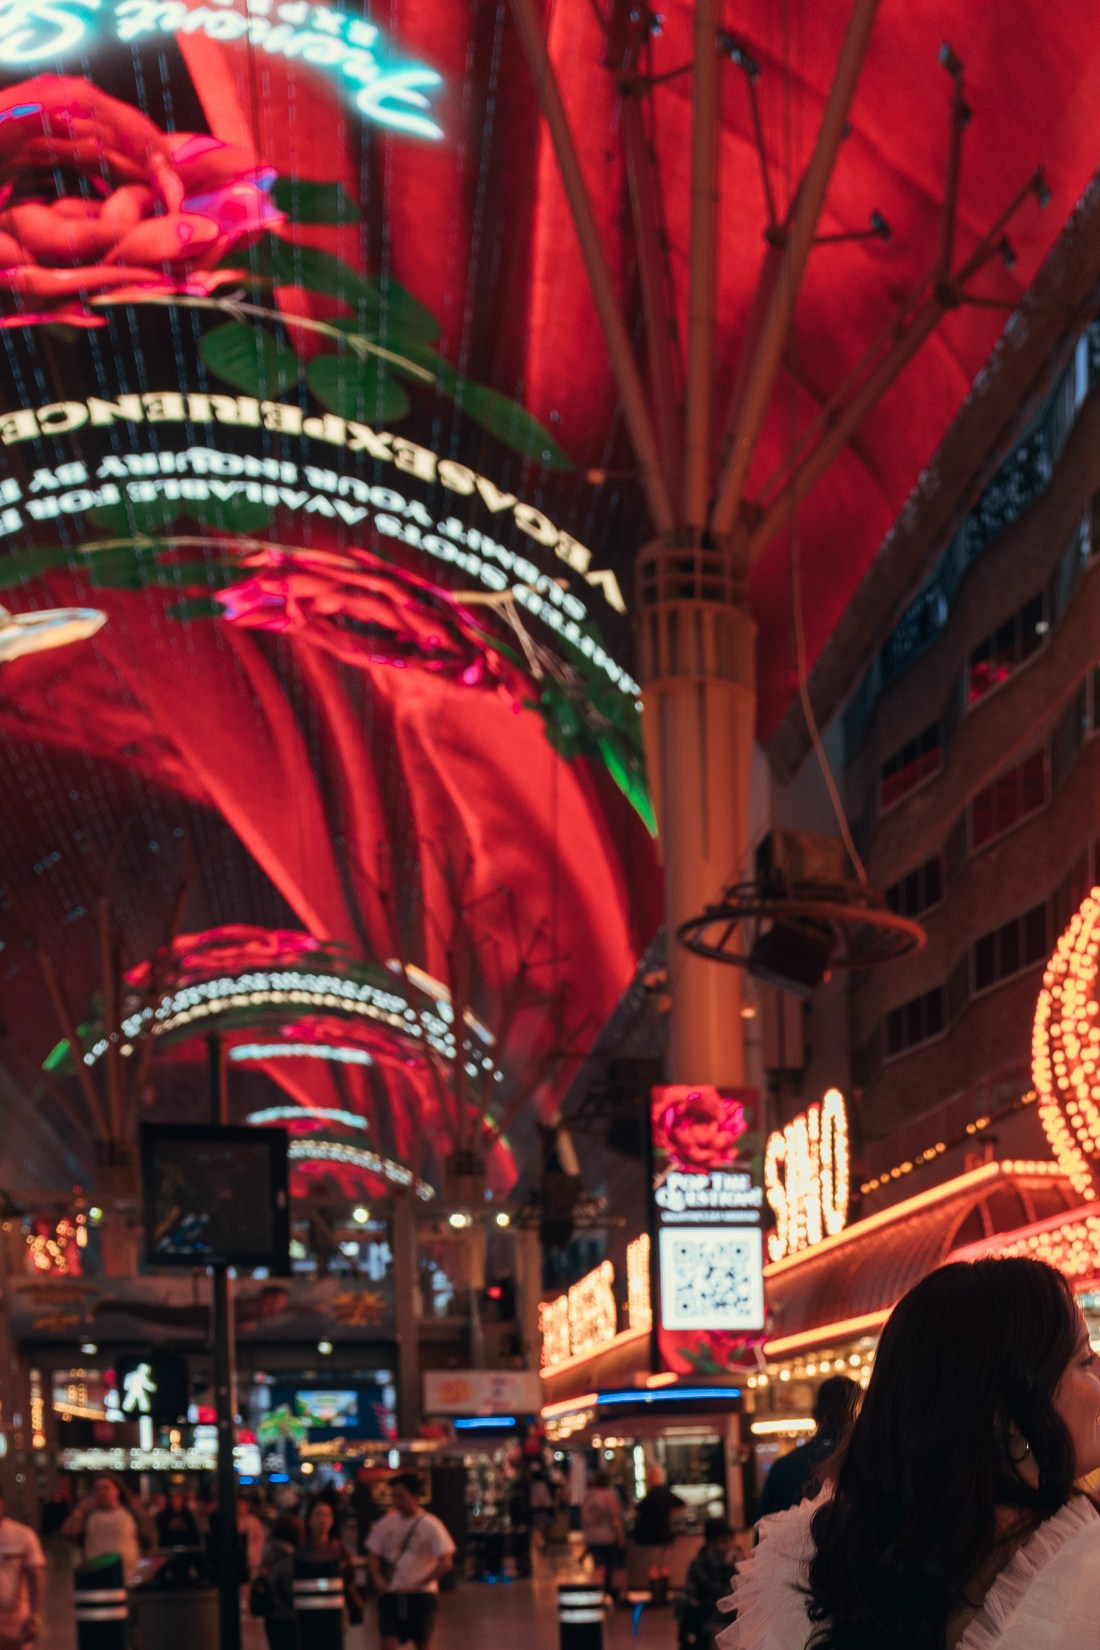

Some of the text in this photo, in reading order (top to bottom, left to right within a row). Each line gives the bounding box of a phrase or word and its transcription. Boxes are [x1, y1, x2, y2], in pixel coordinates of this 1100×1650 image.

[29, 460, 88, 494] BY
[97, 446, 299, 485] INQUIRY
[25, 483, 122, 522] FOR
[126, 477, 369, 526] AVAILABLE
[304, 465, 433, 528] YOUR
[374, 512, 510, 592] SHOTS
[437, 517, 588, 622] SUBMIT
[511, 583, 642, 698] IMITED
